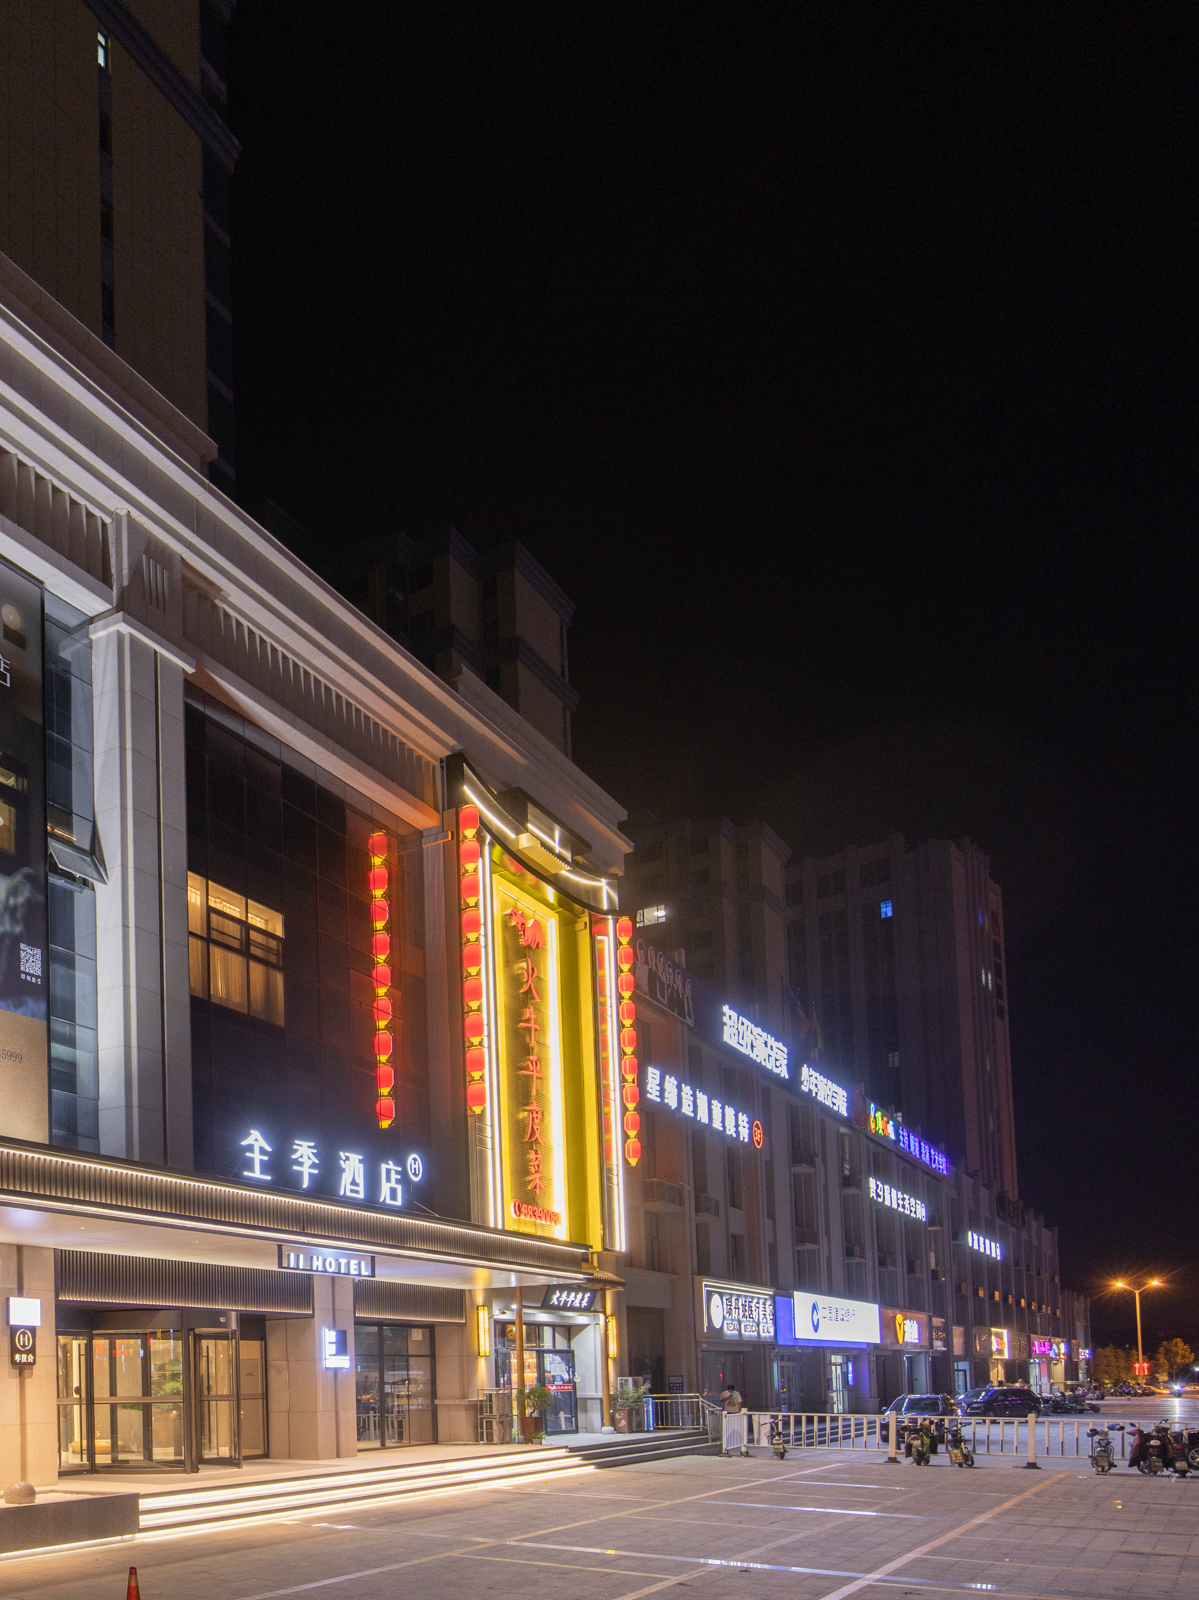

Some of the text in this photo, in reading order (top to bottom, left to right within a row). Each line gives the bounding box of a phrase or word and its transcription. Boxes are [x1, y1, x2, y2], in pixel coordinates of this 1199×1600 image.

[519, 957, 547, 1197] 火牛平度菜
[240, 1129, 403, 1206] 全季酒店
[312, 1255, 369, 1277] HOTEL
